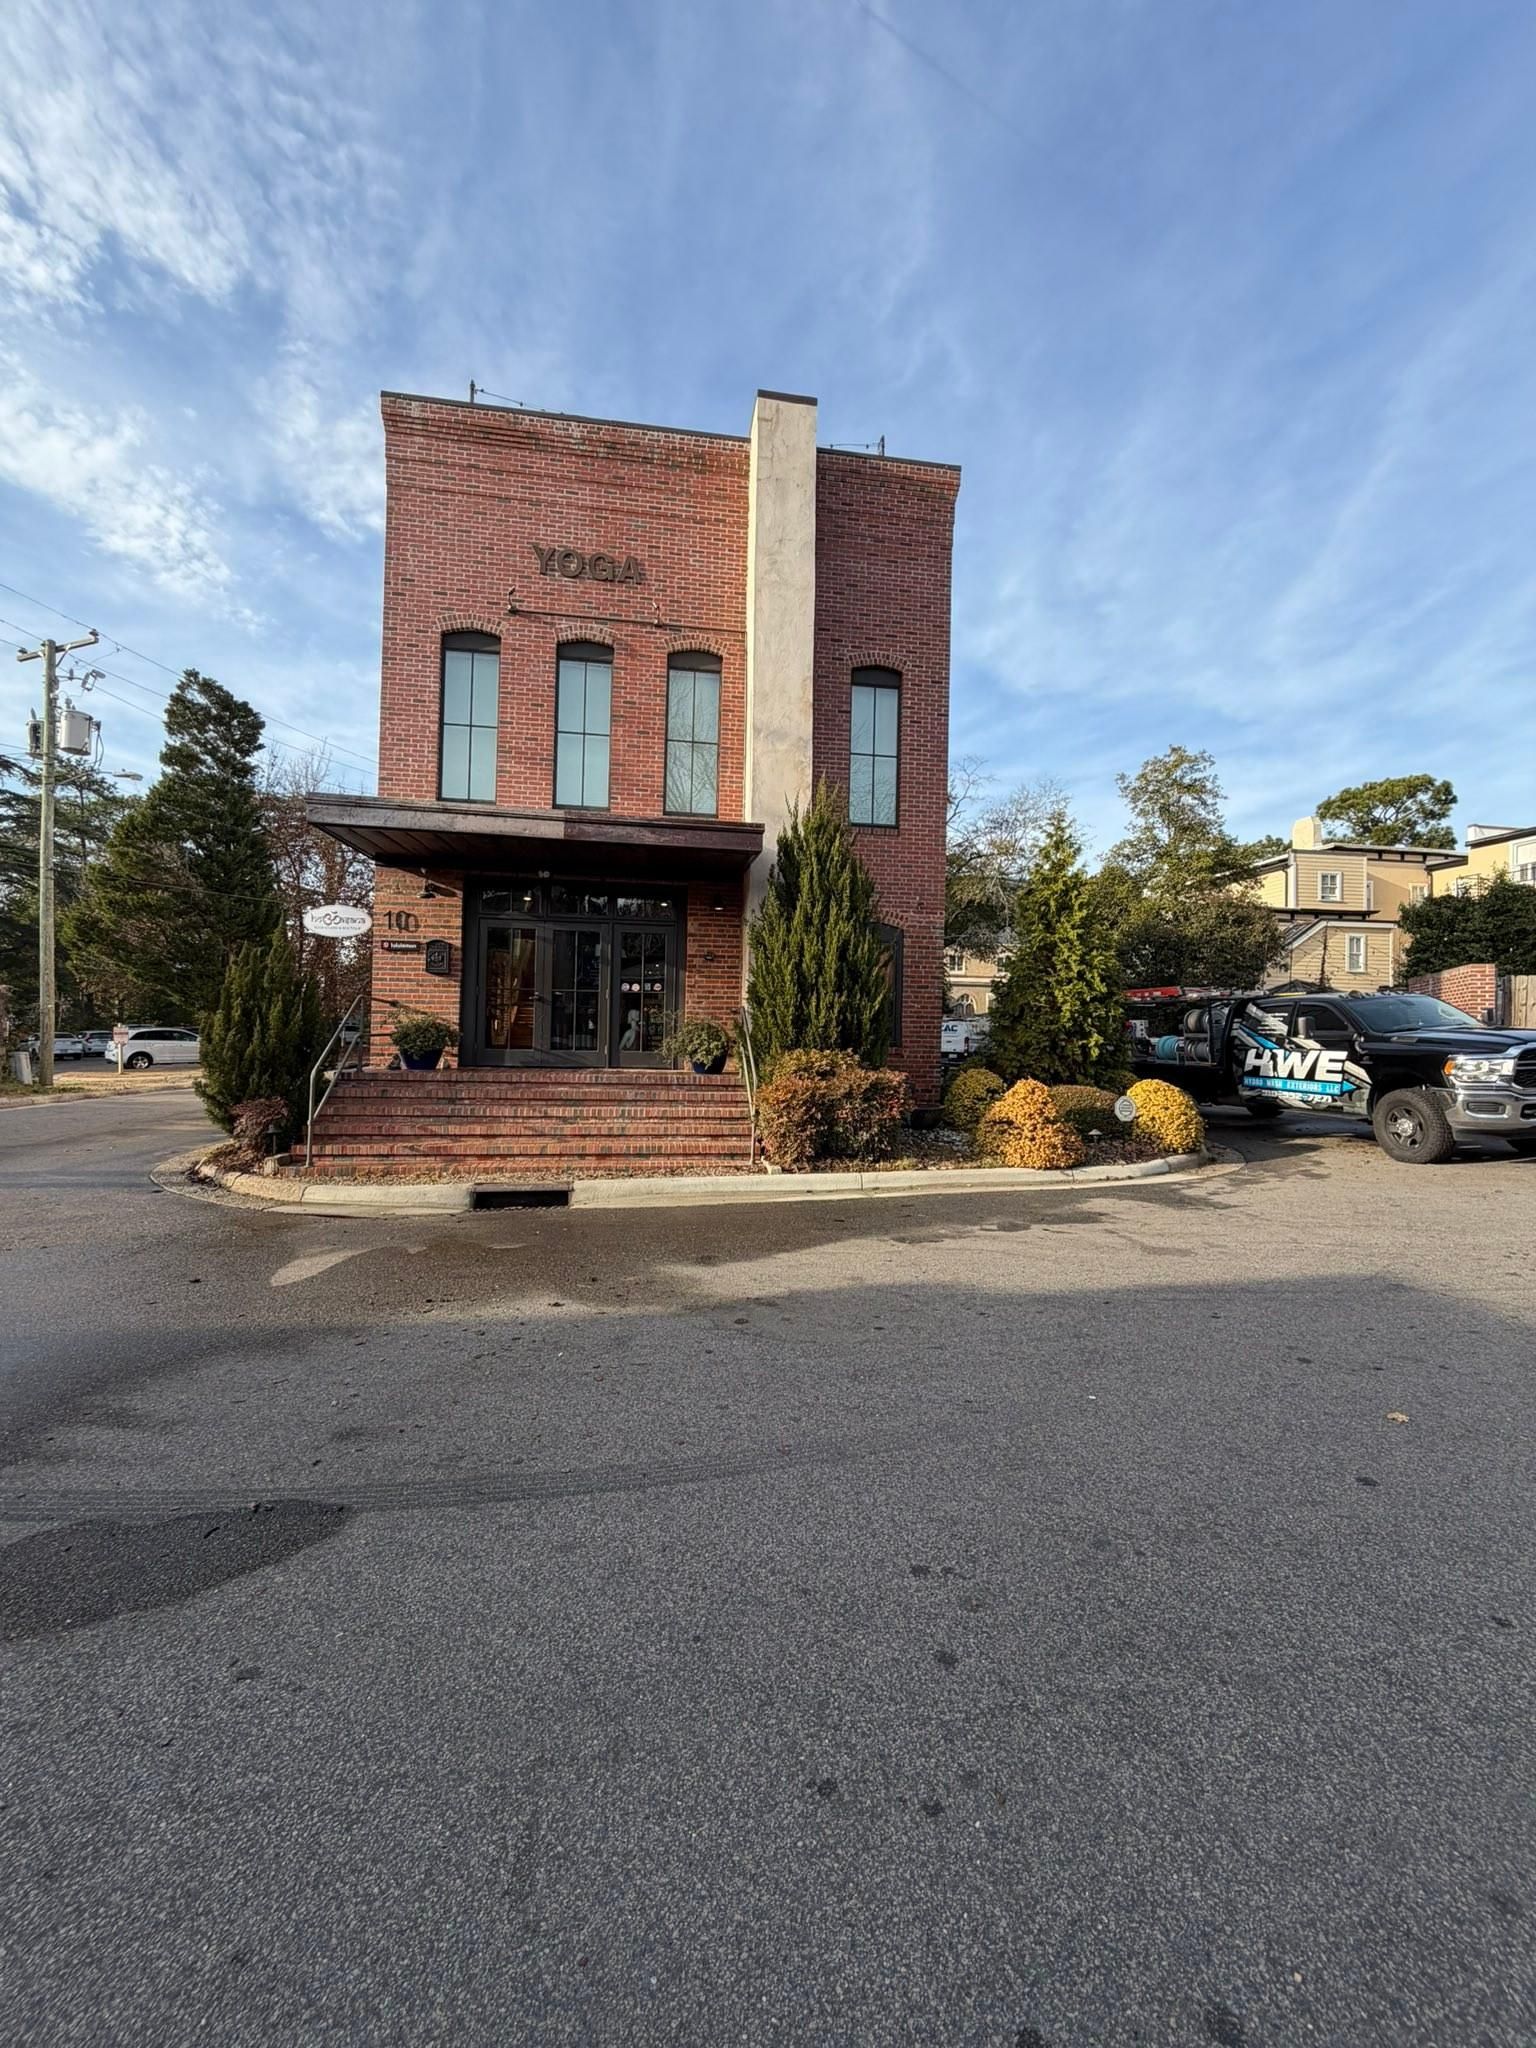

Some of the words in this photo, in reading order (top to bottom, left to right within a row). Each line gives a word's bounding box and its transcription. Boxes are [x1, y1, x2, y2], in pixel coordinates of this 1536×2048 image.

[530, 541, 642, 585] YOGA
[1243, 1047, 1349, 1082] HWE
[1286, 1080, 1323, 1094] EXTERIORS
[1325, 1083, 1342, 1096] LLC
